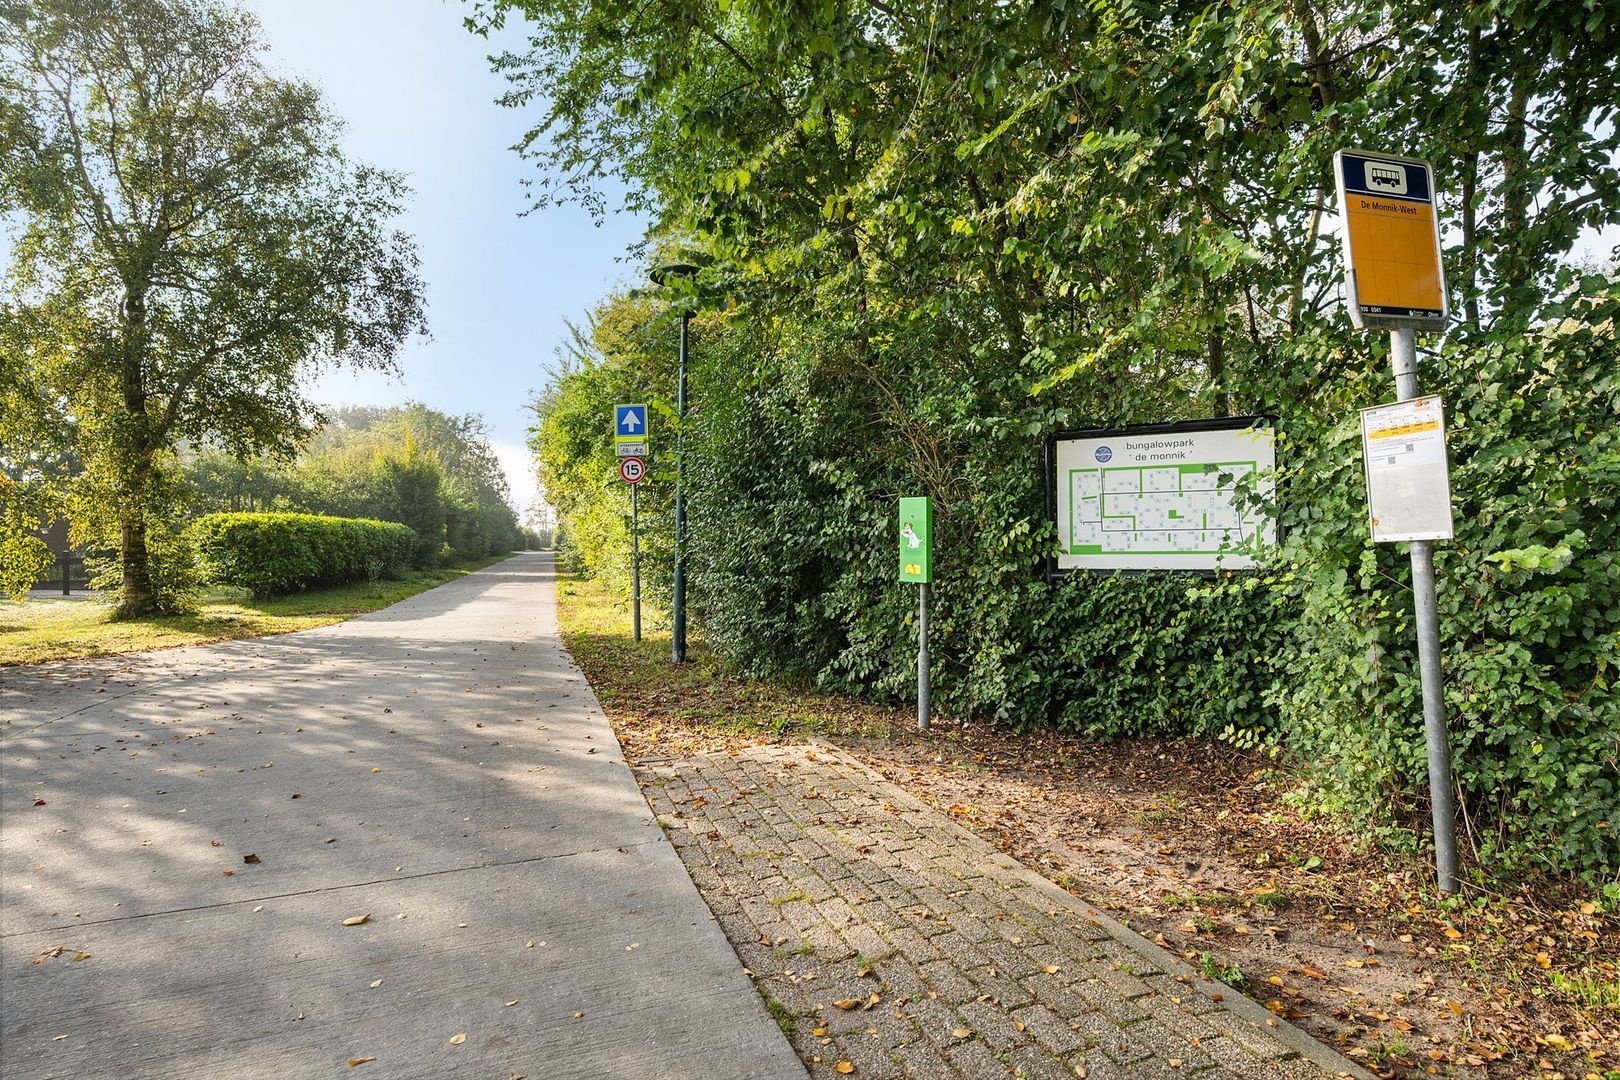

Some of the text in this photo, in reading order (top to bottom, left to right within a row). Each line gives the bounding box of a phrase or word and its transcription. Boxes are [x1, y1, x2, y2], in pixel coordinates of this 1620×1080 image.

[1361, 200, 1417, 215] De Monnik-West
[1126, 438, 1195, 451] bungalowpark
[1135, 453, 1147, 461] de
[1150, 451, 1186, 461] monnik
[625, 464, 640, 476] 15
